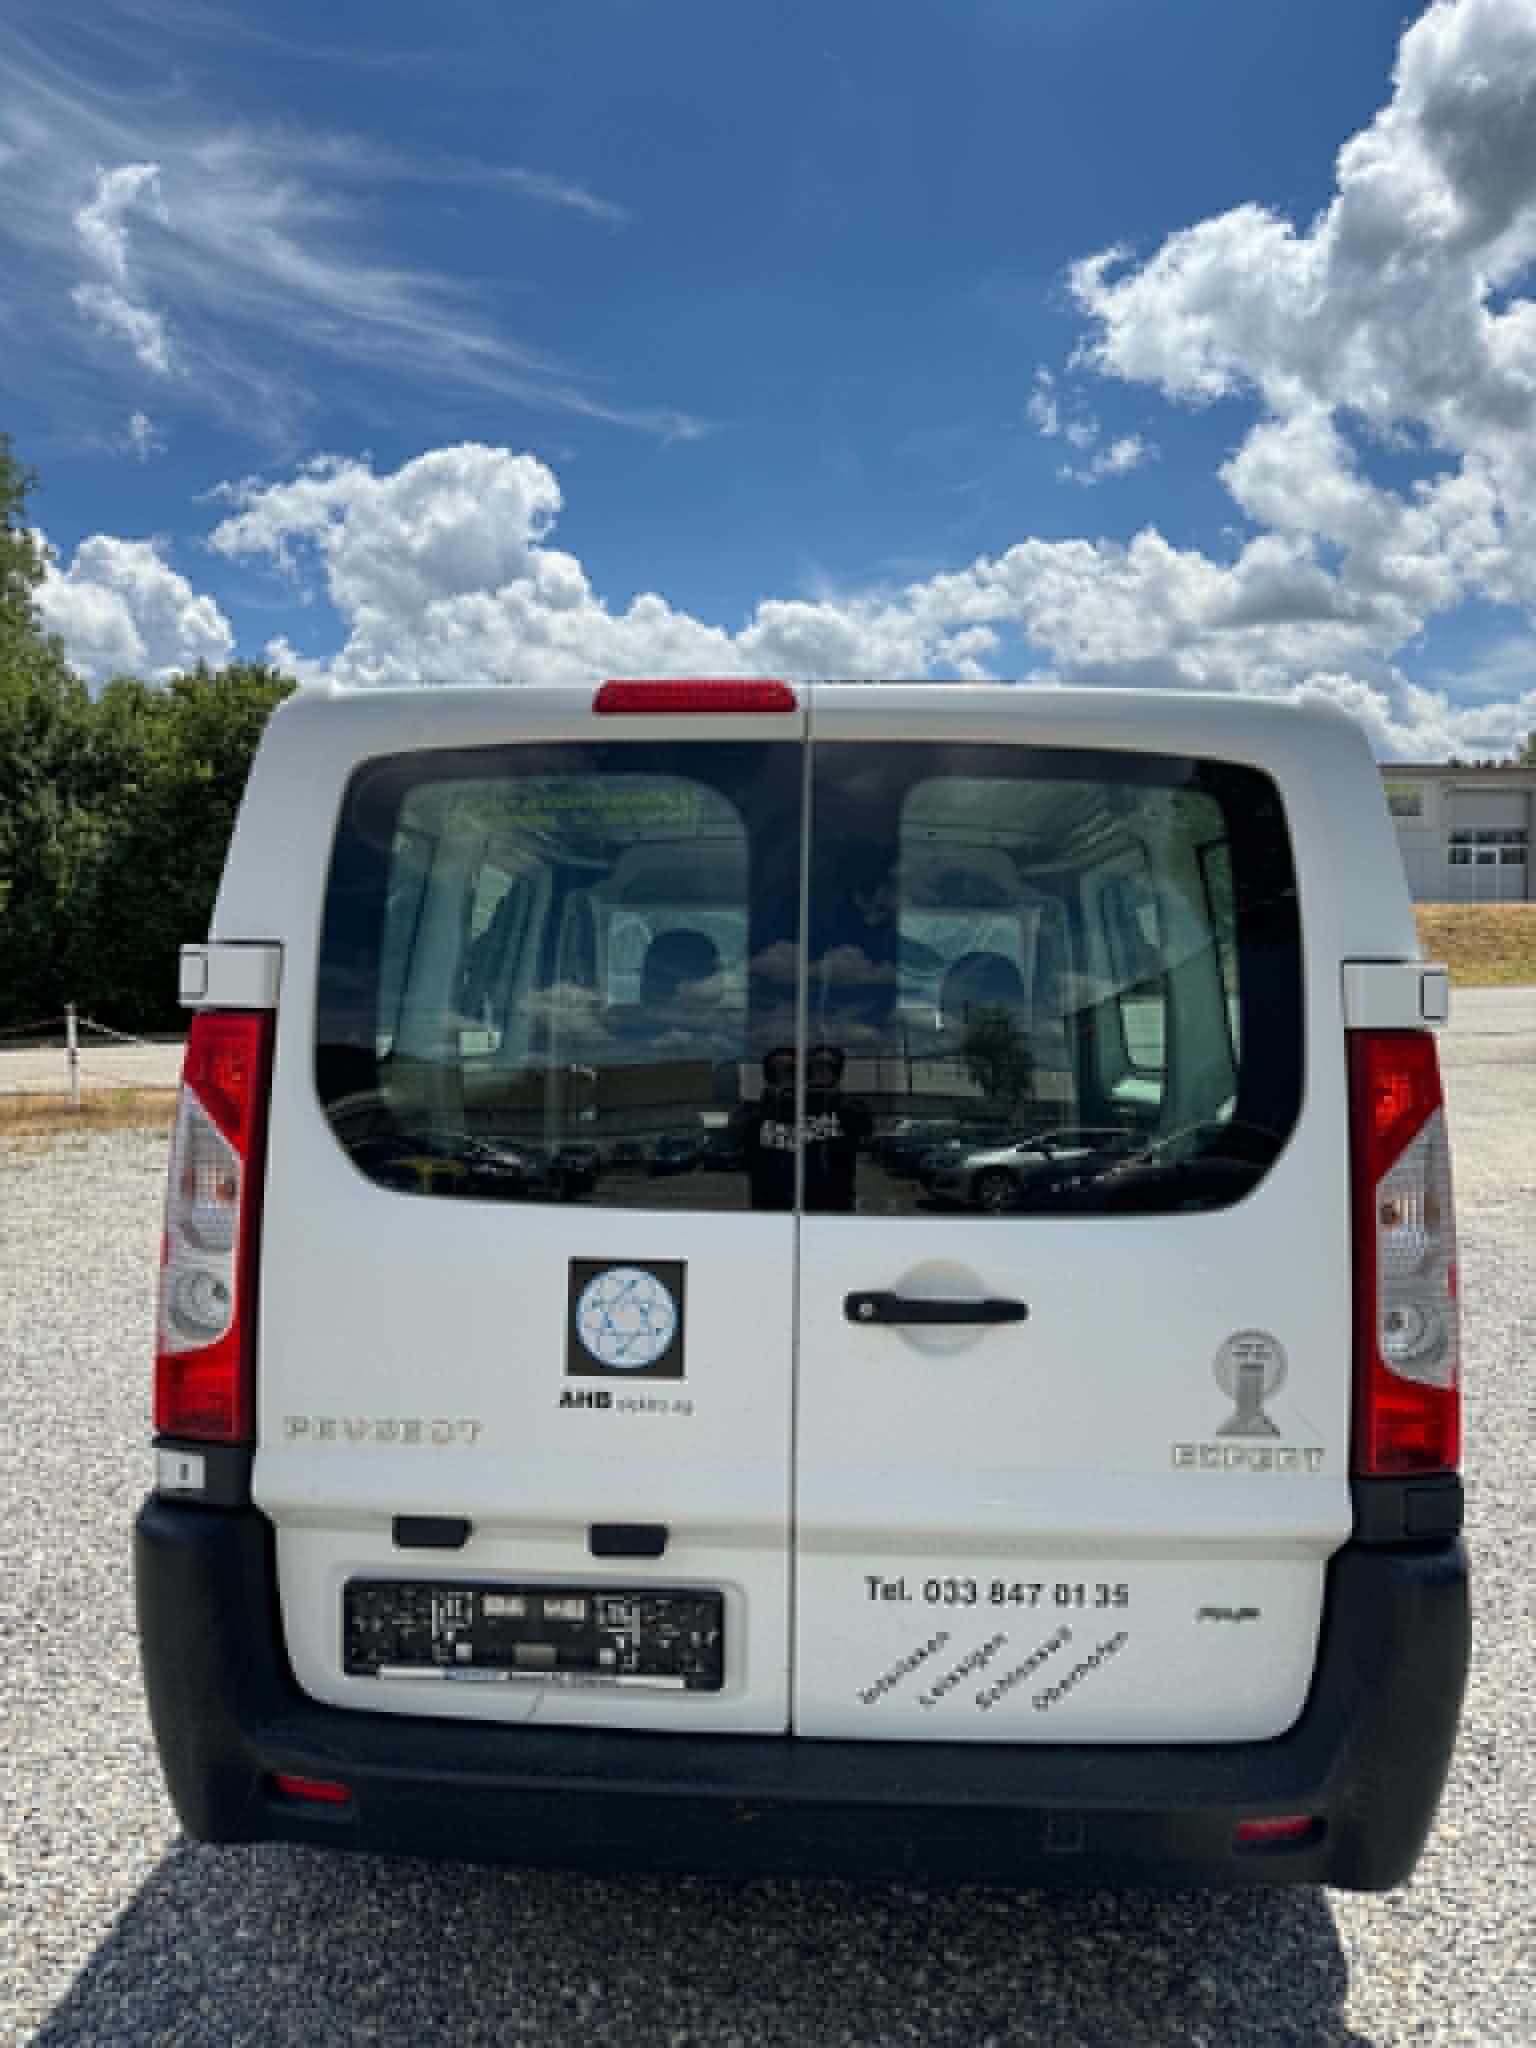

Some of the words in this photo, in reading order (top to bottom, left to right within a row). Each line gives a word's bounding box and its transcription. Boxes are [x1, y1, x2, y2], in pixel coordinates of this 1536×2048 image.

[283, 1414, 482, 1446] PEUGEOT
[1170, 1442, 1325, 1472] EXPERT
[865, 1576, 913, 1602] Tel.
[922, 1577, 978, 1606] 033
[989, 1580, 1044, 1607] 847
[1052, 1582, 1085, 1608] 01
[1094, 1583, 1130, 1608] 35
[1032, 1630, 1128, 1711] Oberhofen
